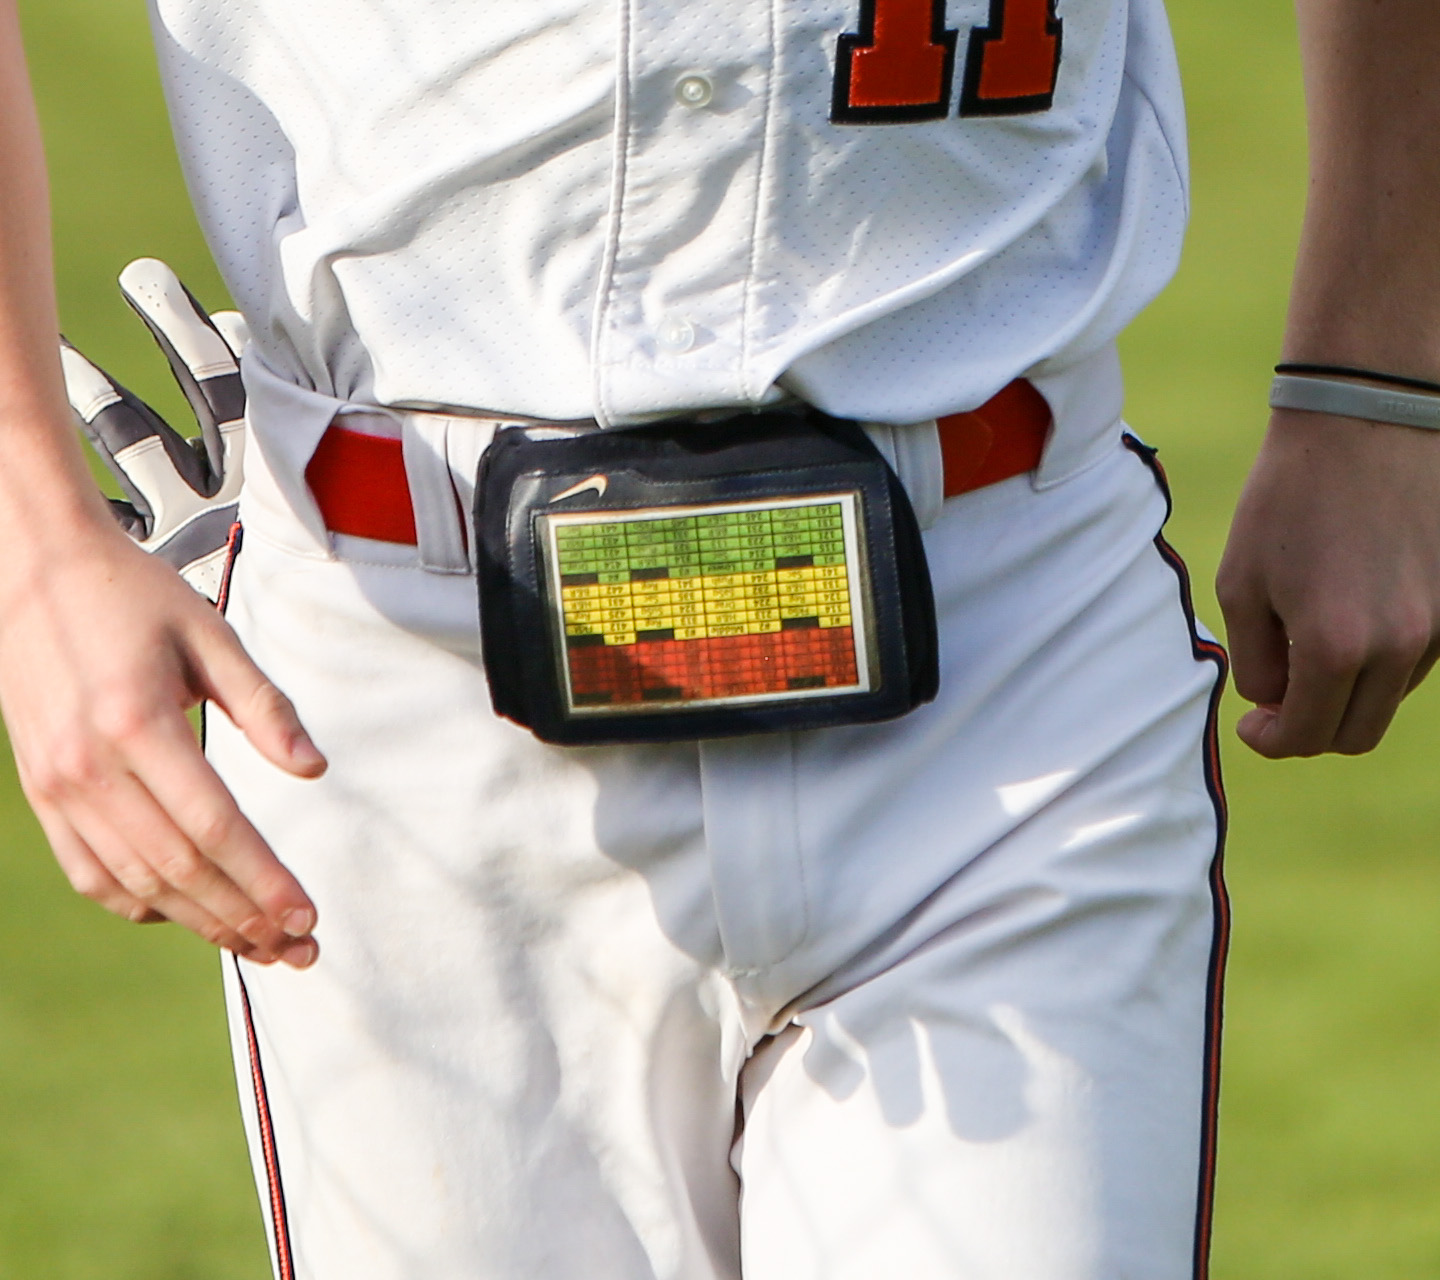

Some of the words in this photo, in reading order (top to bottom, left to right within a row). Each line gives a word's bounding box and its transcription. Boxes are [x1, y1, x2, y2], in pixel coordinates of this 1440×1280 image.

[707, 563, 736, 574] Lower
[822, 568, 838, 577] 141
[751, 574, 768, 583] 244
[753, 598, 770, 607] 224
[789, 594, 805, 604] Reg
[711, 624, 744, 635] Middle
